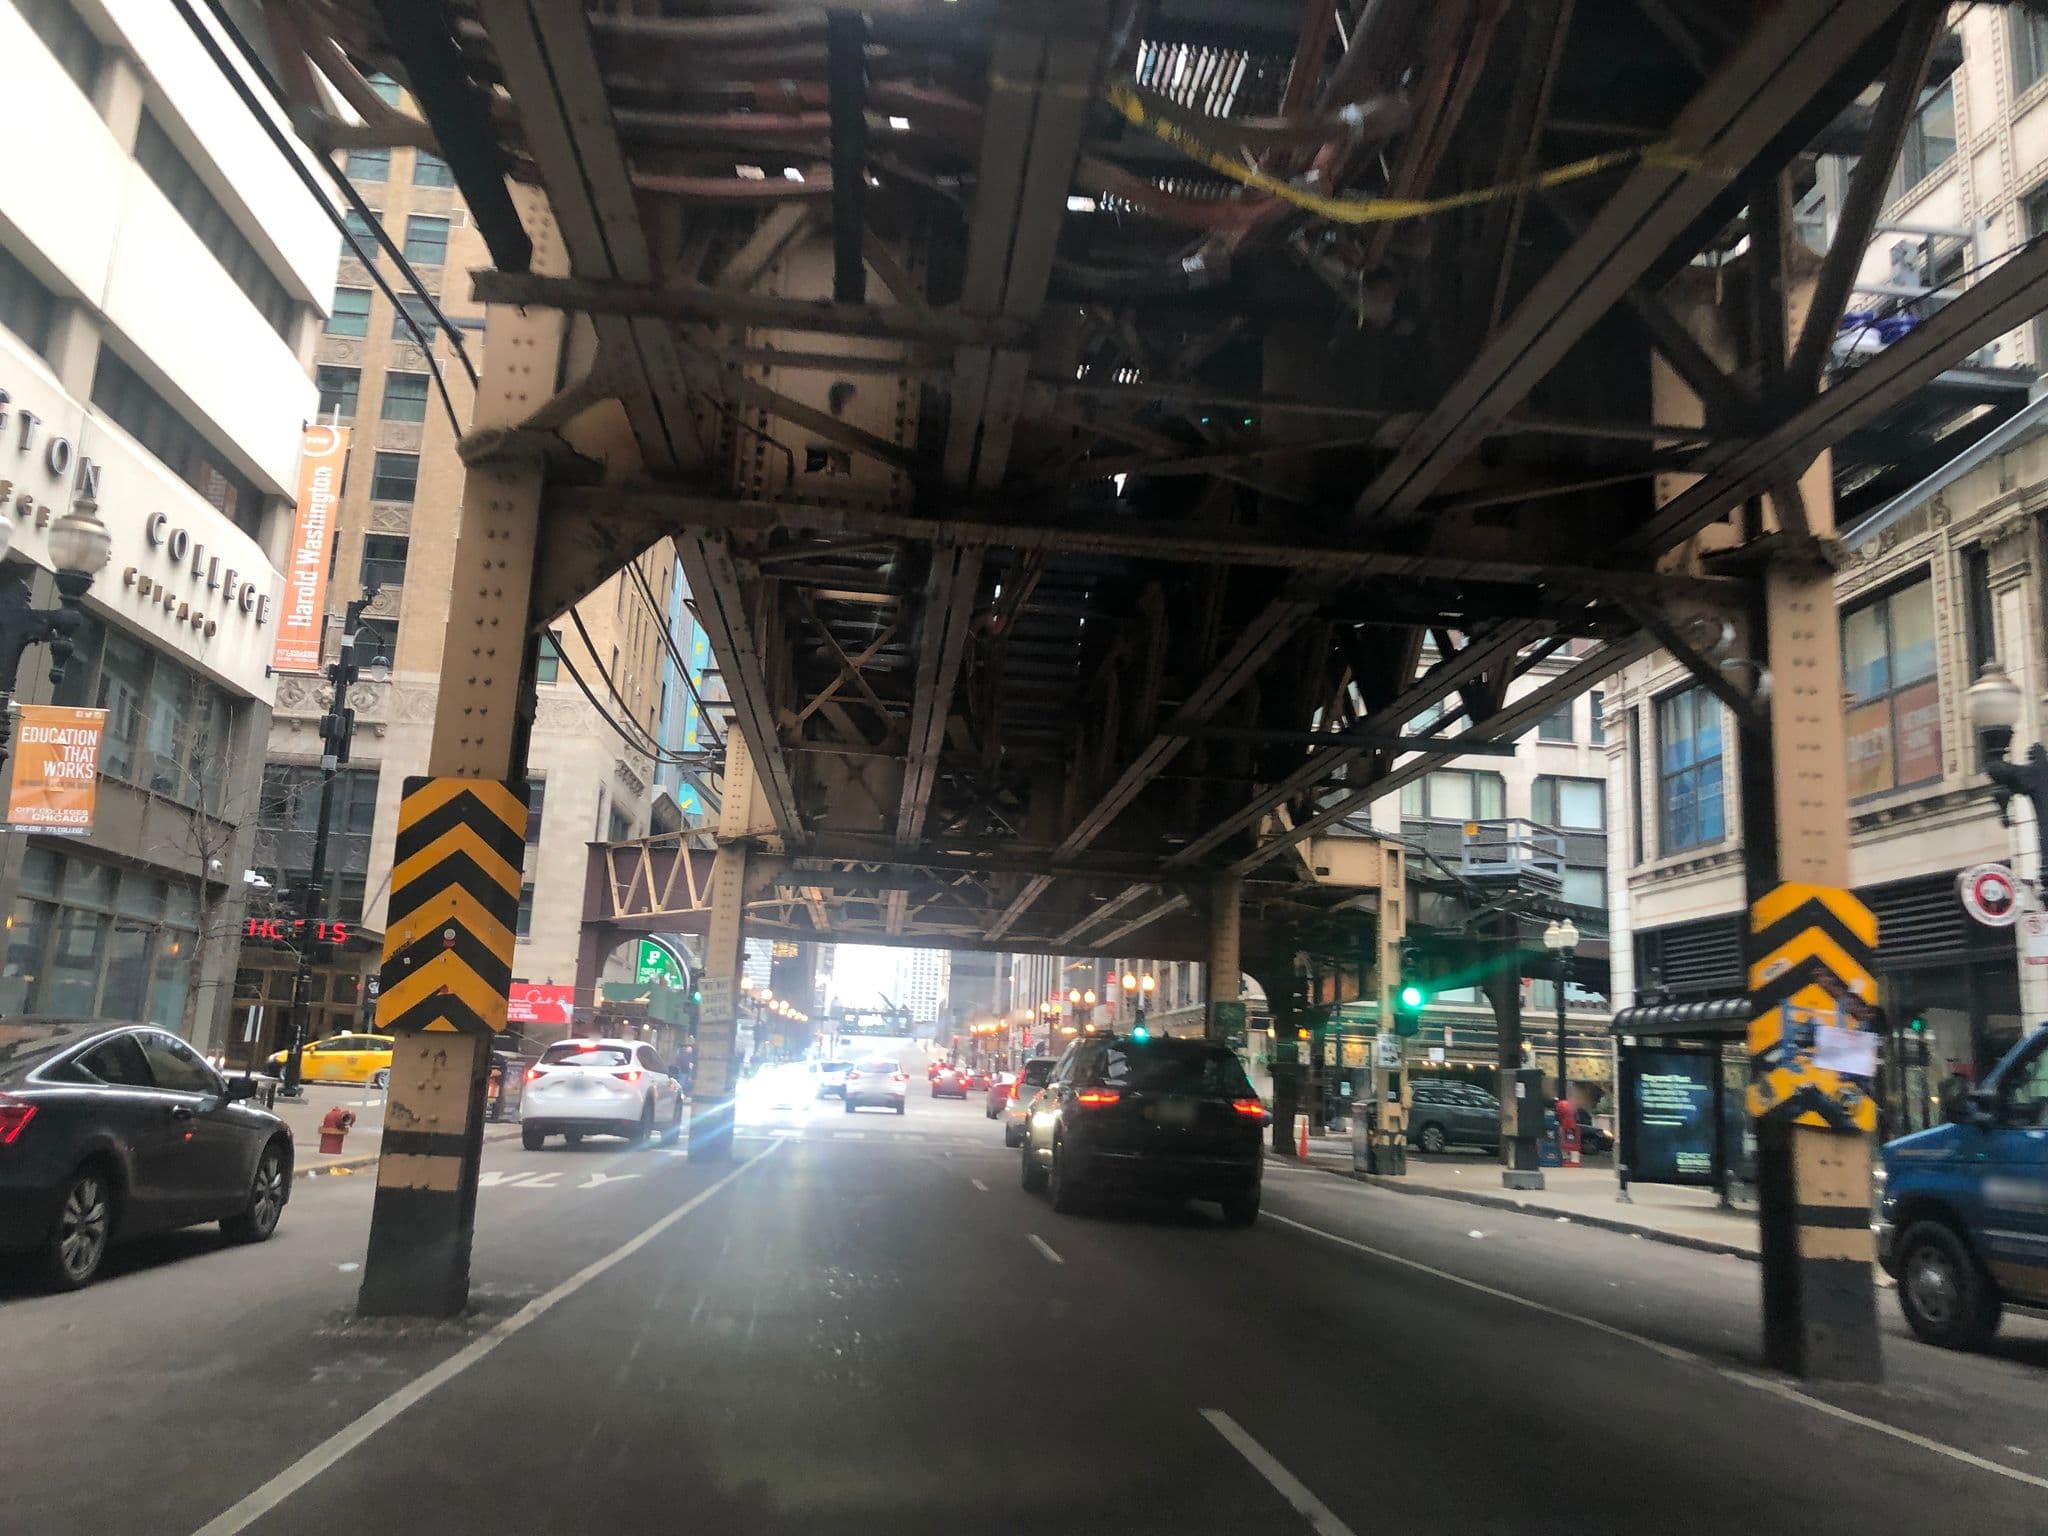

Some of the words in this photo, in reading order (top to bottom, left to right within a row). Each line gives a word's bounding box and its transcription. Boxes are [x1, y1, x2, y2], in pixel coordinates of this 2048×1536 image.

[0, 388, 102, 499] TON
[146, 511, 271, 624] COLLEGE
[296, 465, 335, 565] Washington
[123, 566, 217, 637] CHICAGO
[287, 570, 317, 627] Harold
[21, 726, 98, 746] EDUCATION
[63, 745, 97, 763] THAT
[43, 760, 95, 779] WORKS
[15, 806, 36, 815] CITY
[31, 813, 89, 823] CHICAGO
